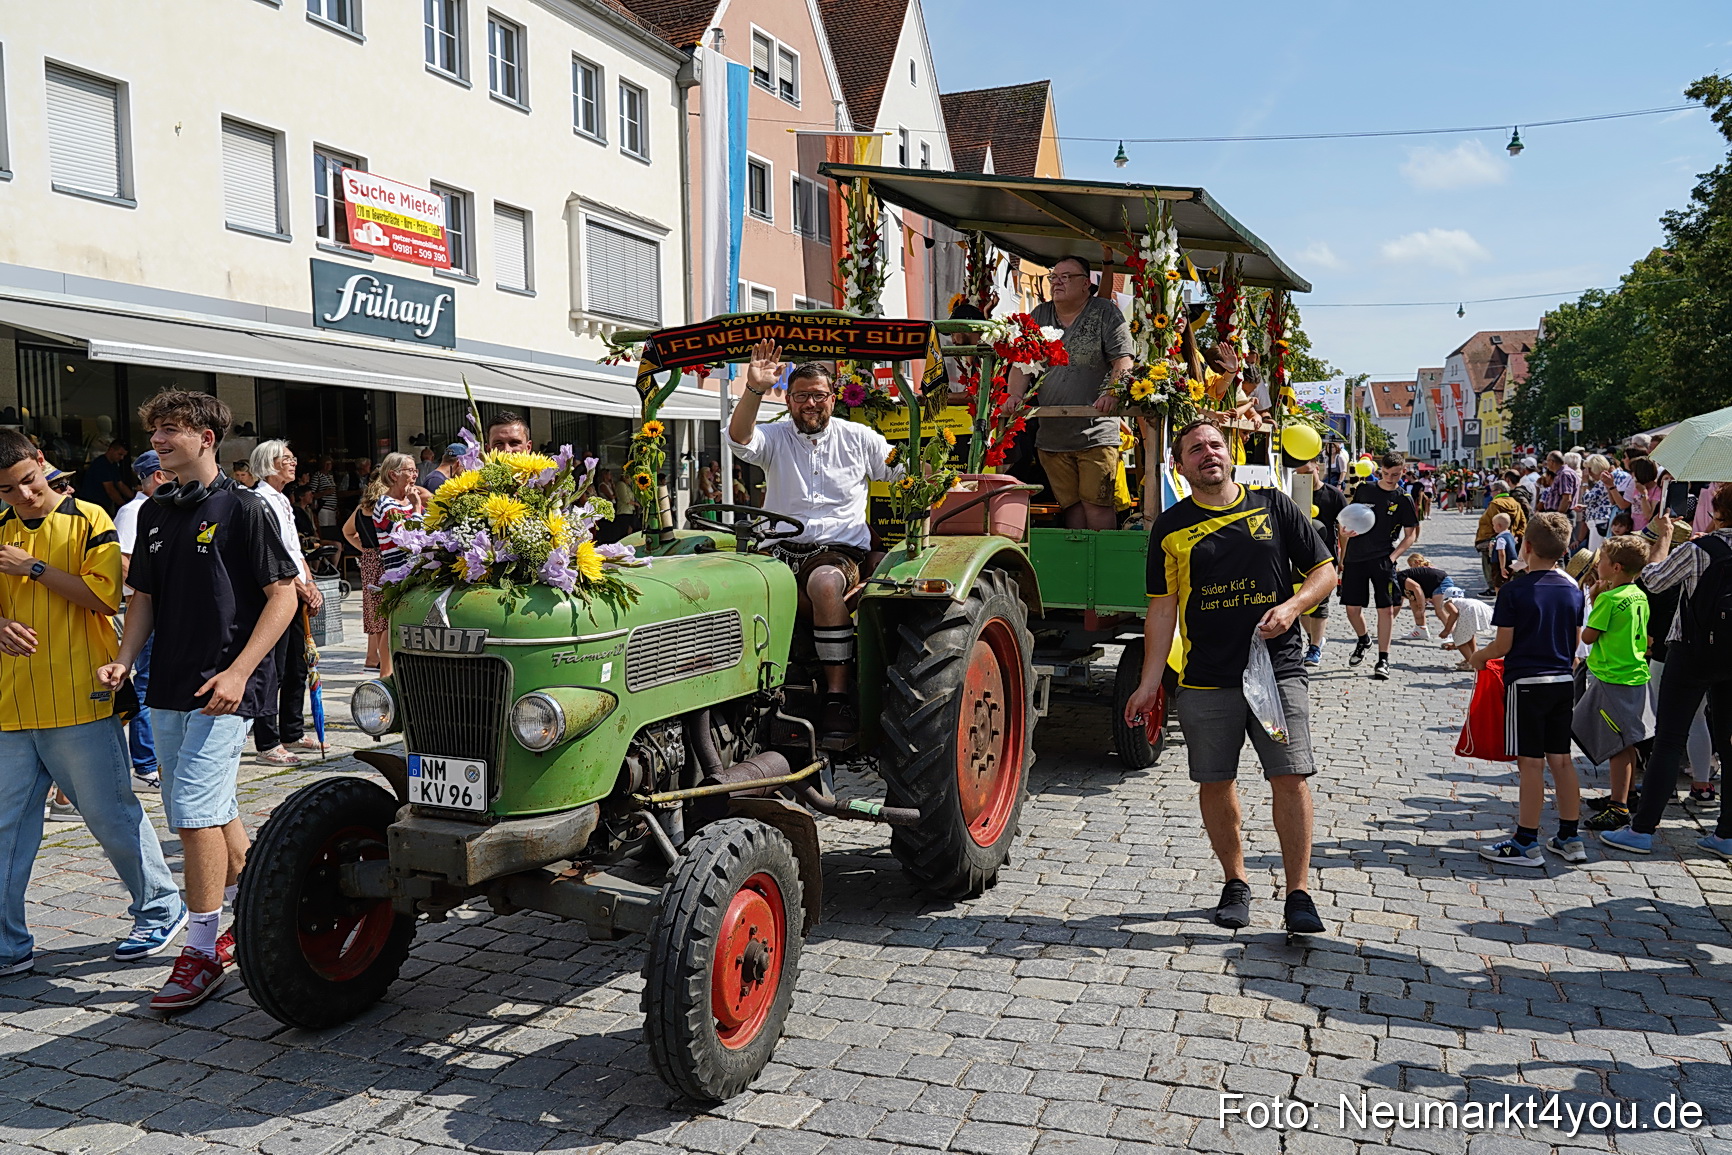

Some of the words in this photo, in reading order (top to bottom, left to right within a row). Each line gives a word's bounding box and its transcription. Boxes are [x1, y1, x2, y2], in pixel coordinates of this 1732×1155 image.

[348, 178, 396, 205] Suche
[400, 191, 442, 218] Mieter!
[392, 242, 413, 256] 09181
[418, 248, 433, 260] 509
[433, 251, 447, 263] 390
[721, 312, 786, 328] YOU'LL
[789, 315, 852, 327] NEVER
[670, 335, 703, 353] FC
[706, 324, 861, 347] NEUMARKT
[865, 325, 926, 345] SÜD
[784, 343, 847, 355] ALONE
[877, 518, 890, 526] Wir
[1187, 531, 1205, 542] erima
[1201, 582, 1228, 596] Süder
[1200, 599, 1220, 611] Lust
[1222, 594, 1240, 608] auf
[1243, 590, 1277, 606] Fußball
[400, 627, 485, 653] FENDT
[552, 649, 614, 668] Farmer
[412, 768, 418, 776] D
[421, 758, 447, 782] NM
[420, 780, 446, 804] KV
[448, 784, 473, 808] 96
